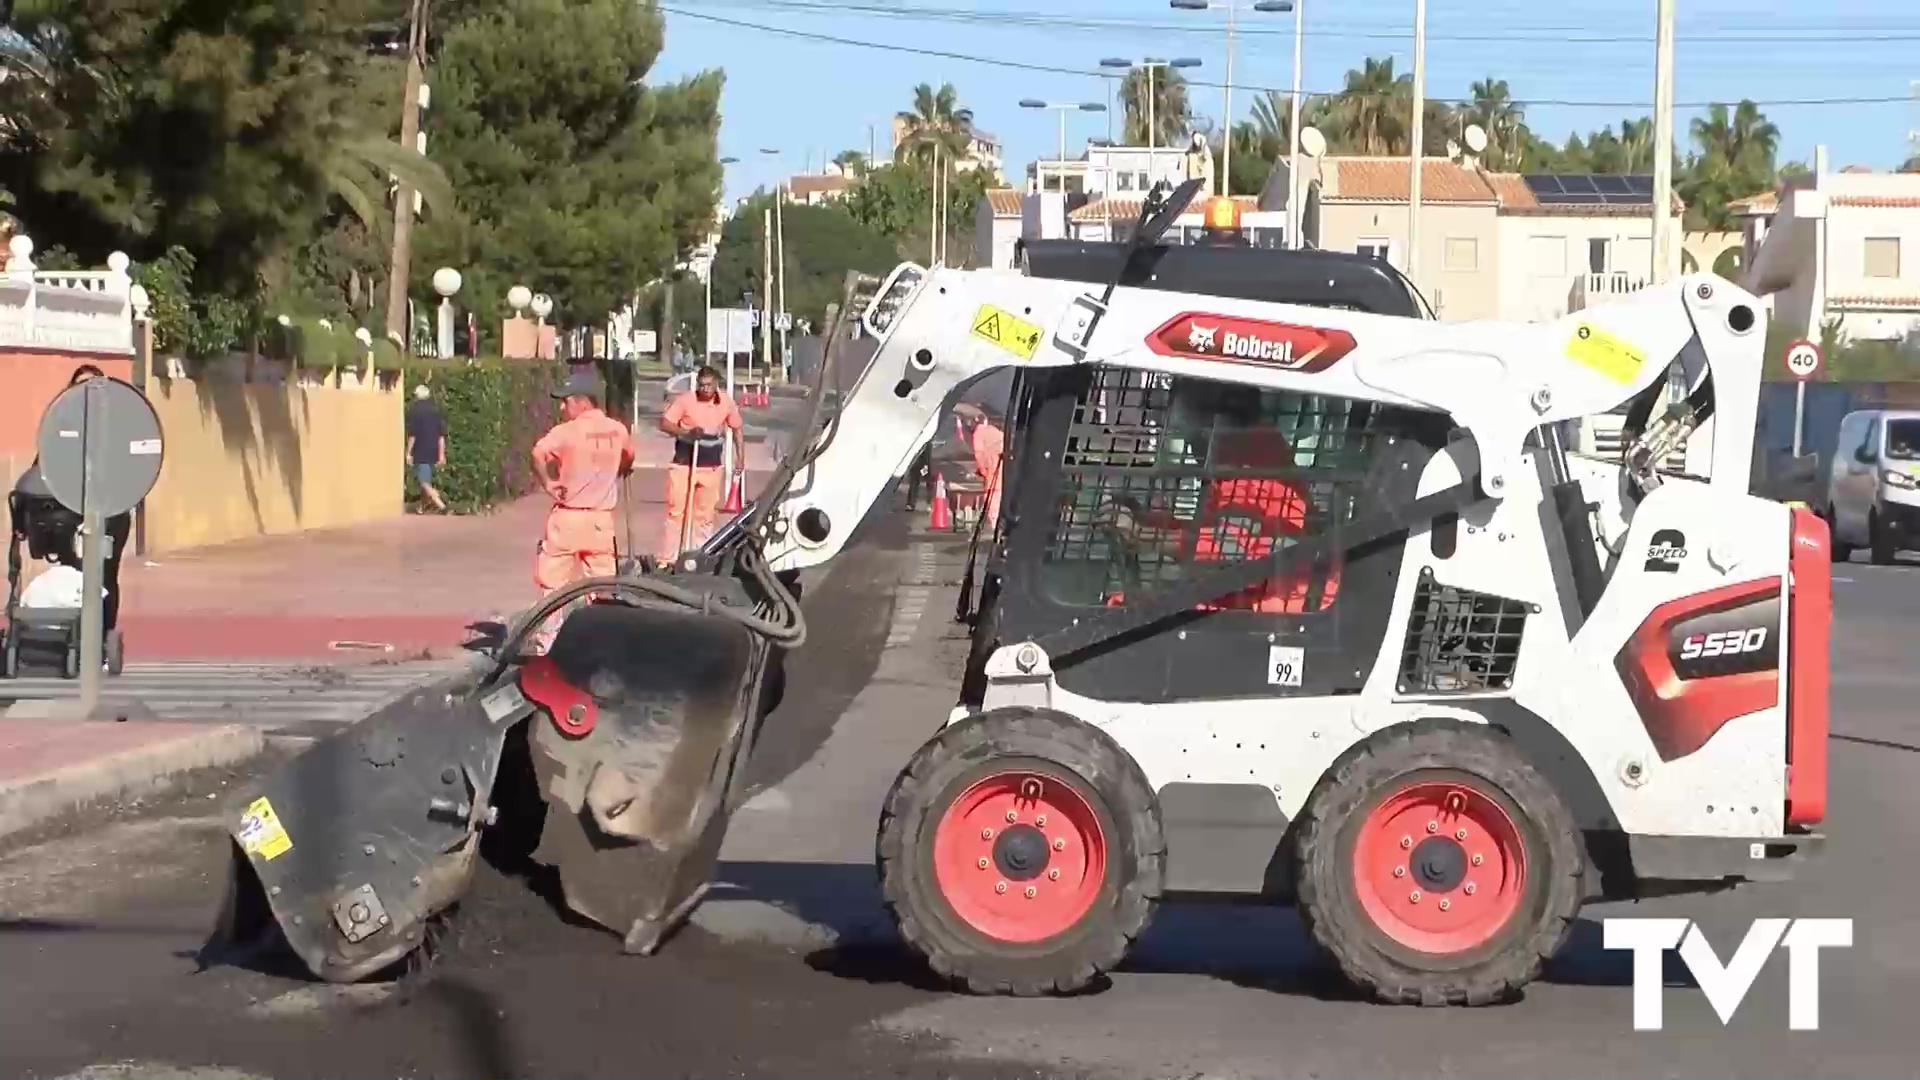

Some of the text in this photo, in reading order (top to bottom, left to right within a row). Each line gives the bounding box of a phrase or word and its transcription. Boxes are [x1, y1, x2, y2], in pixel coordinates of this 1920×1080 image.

[1223, 333, 1293, 361] Bobcat
[1793, 354, 1814, 367] 40
[1644, 529, 1686, 573] 2
[1647, 547, 1688, 559] SPEED
[1680, 627, 1767, 660] S530
[1276, 663, 1292, 682] 99
